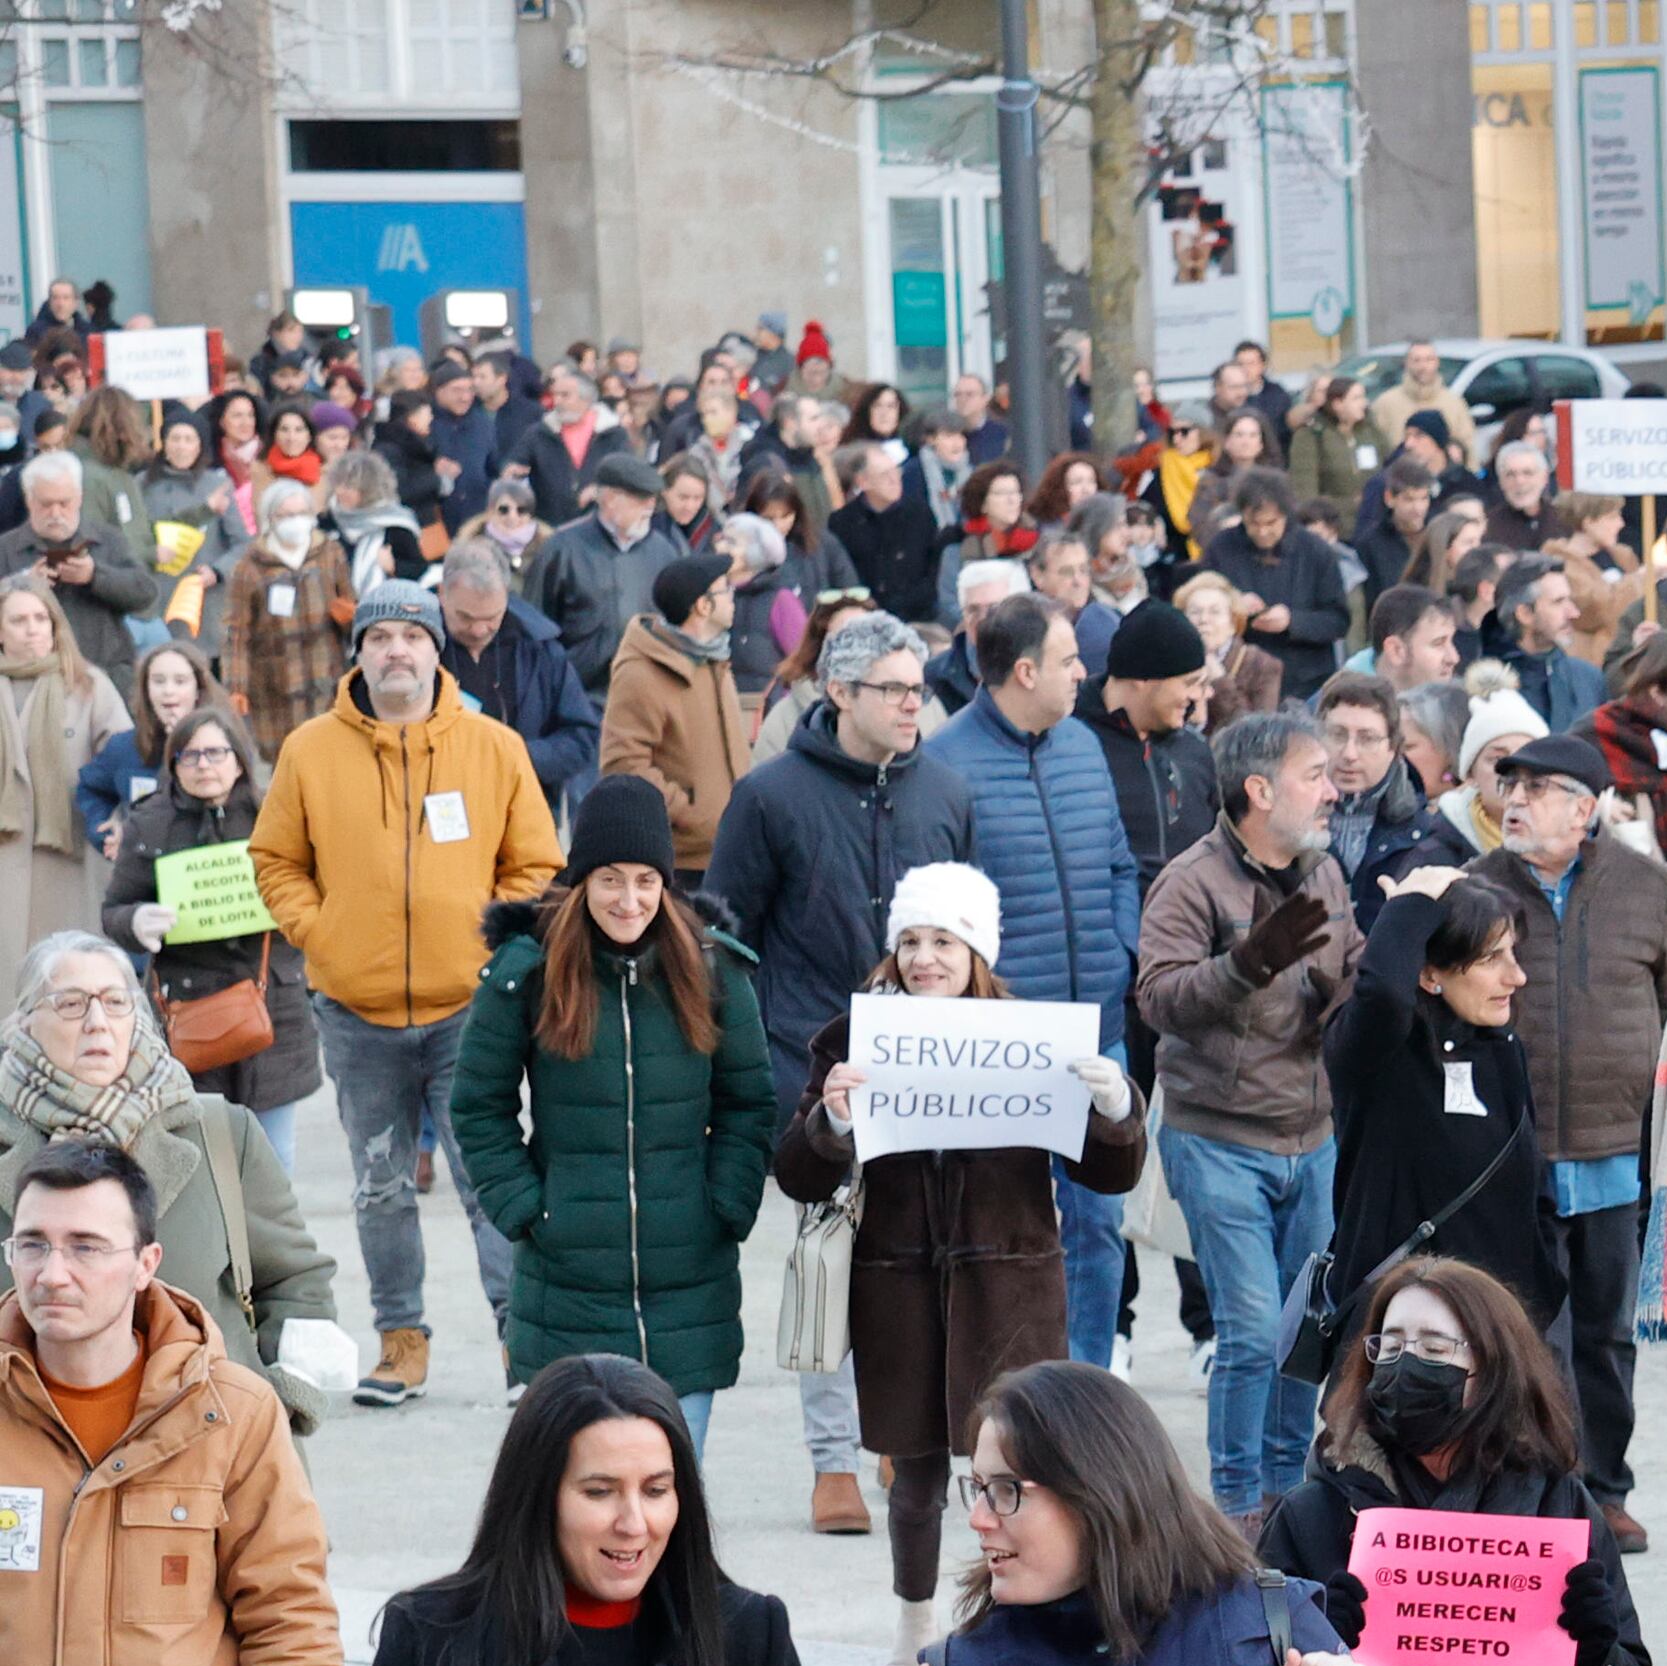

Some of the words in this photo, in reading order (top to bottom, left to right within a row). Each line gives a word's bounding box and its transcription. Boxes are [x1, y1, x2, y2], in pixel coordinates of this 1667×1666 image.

[193, 872, 250, 890] ESCOITA
[190, 894, 235, 910] BIBLIO
[198, 916, 217, 928] DE
[220, 909, 258, 924] LOITA
[871, 1033, 1053, 1072] SERVIZOS
[868, 1086, 1053, 1119] PÚBLICOS
[1371, 1531, 1387, 1549] A
[1395, 1532, 1531, 1558] BIBIOTECA
[1538, 1541, 1554, 1559] E
[1374, 1566, 1408, 1587] @S
[1416, 1568, 1543, 1593] USUARI@S
[1395, 1601, 1517, 1623] MERECEN
[1396, 1634, 1511, 1658] RESPETO
